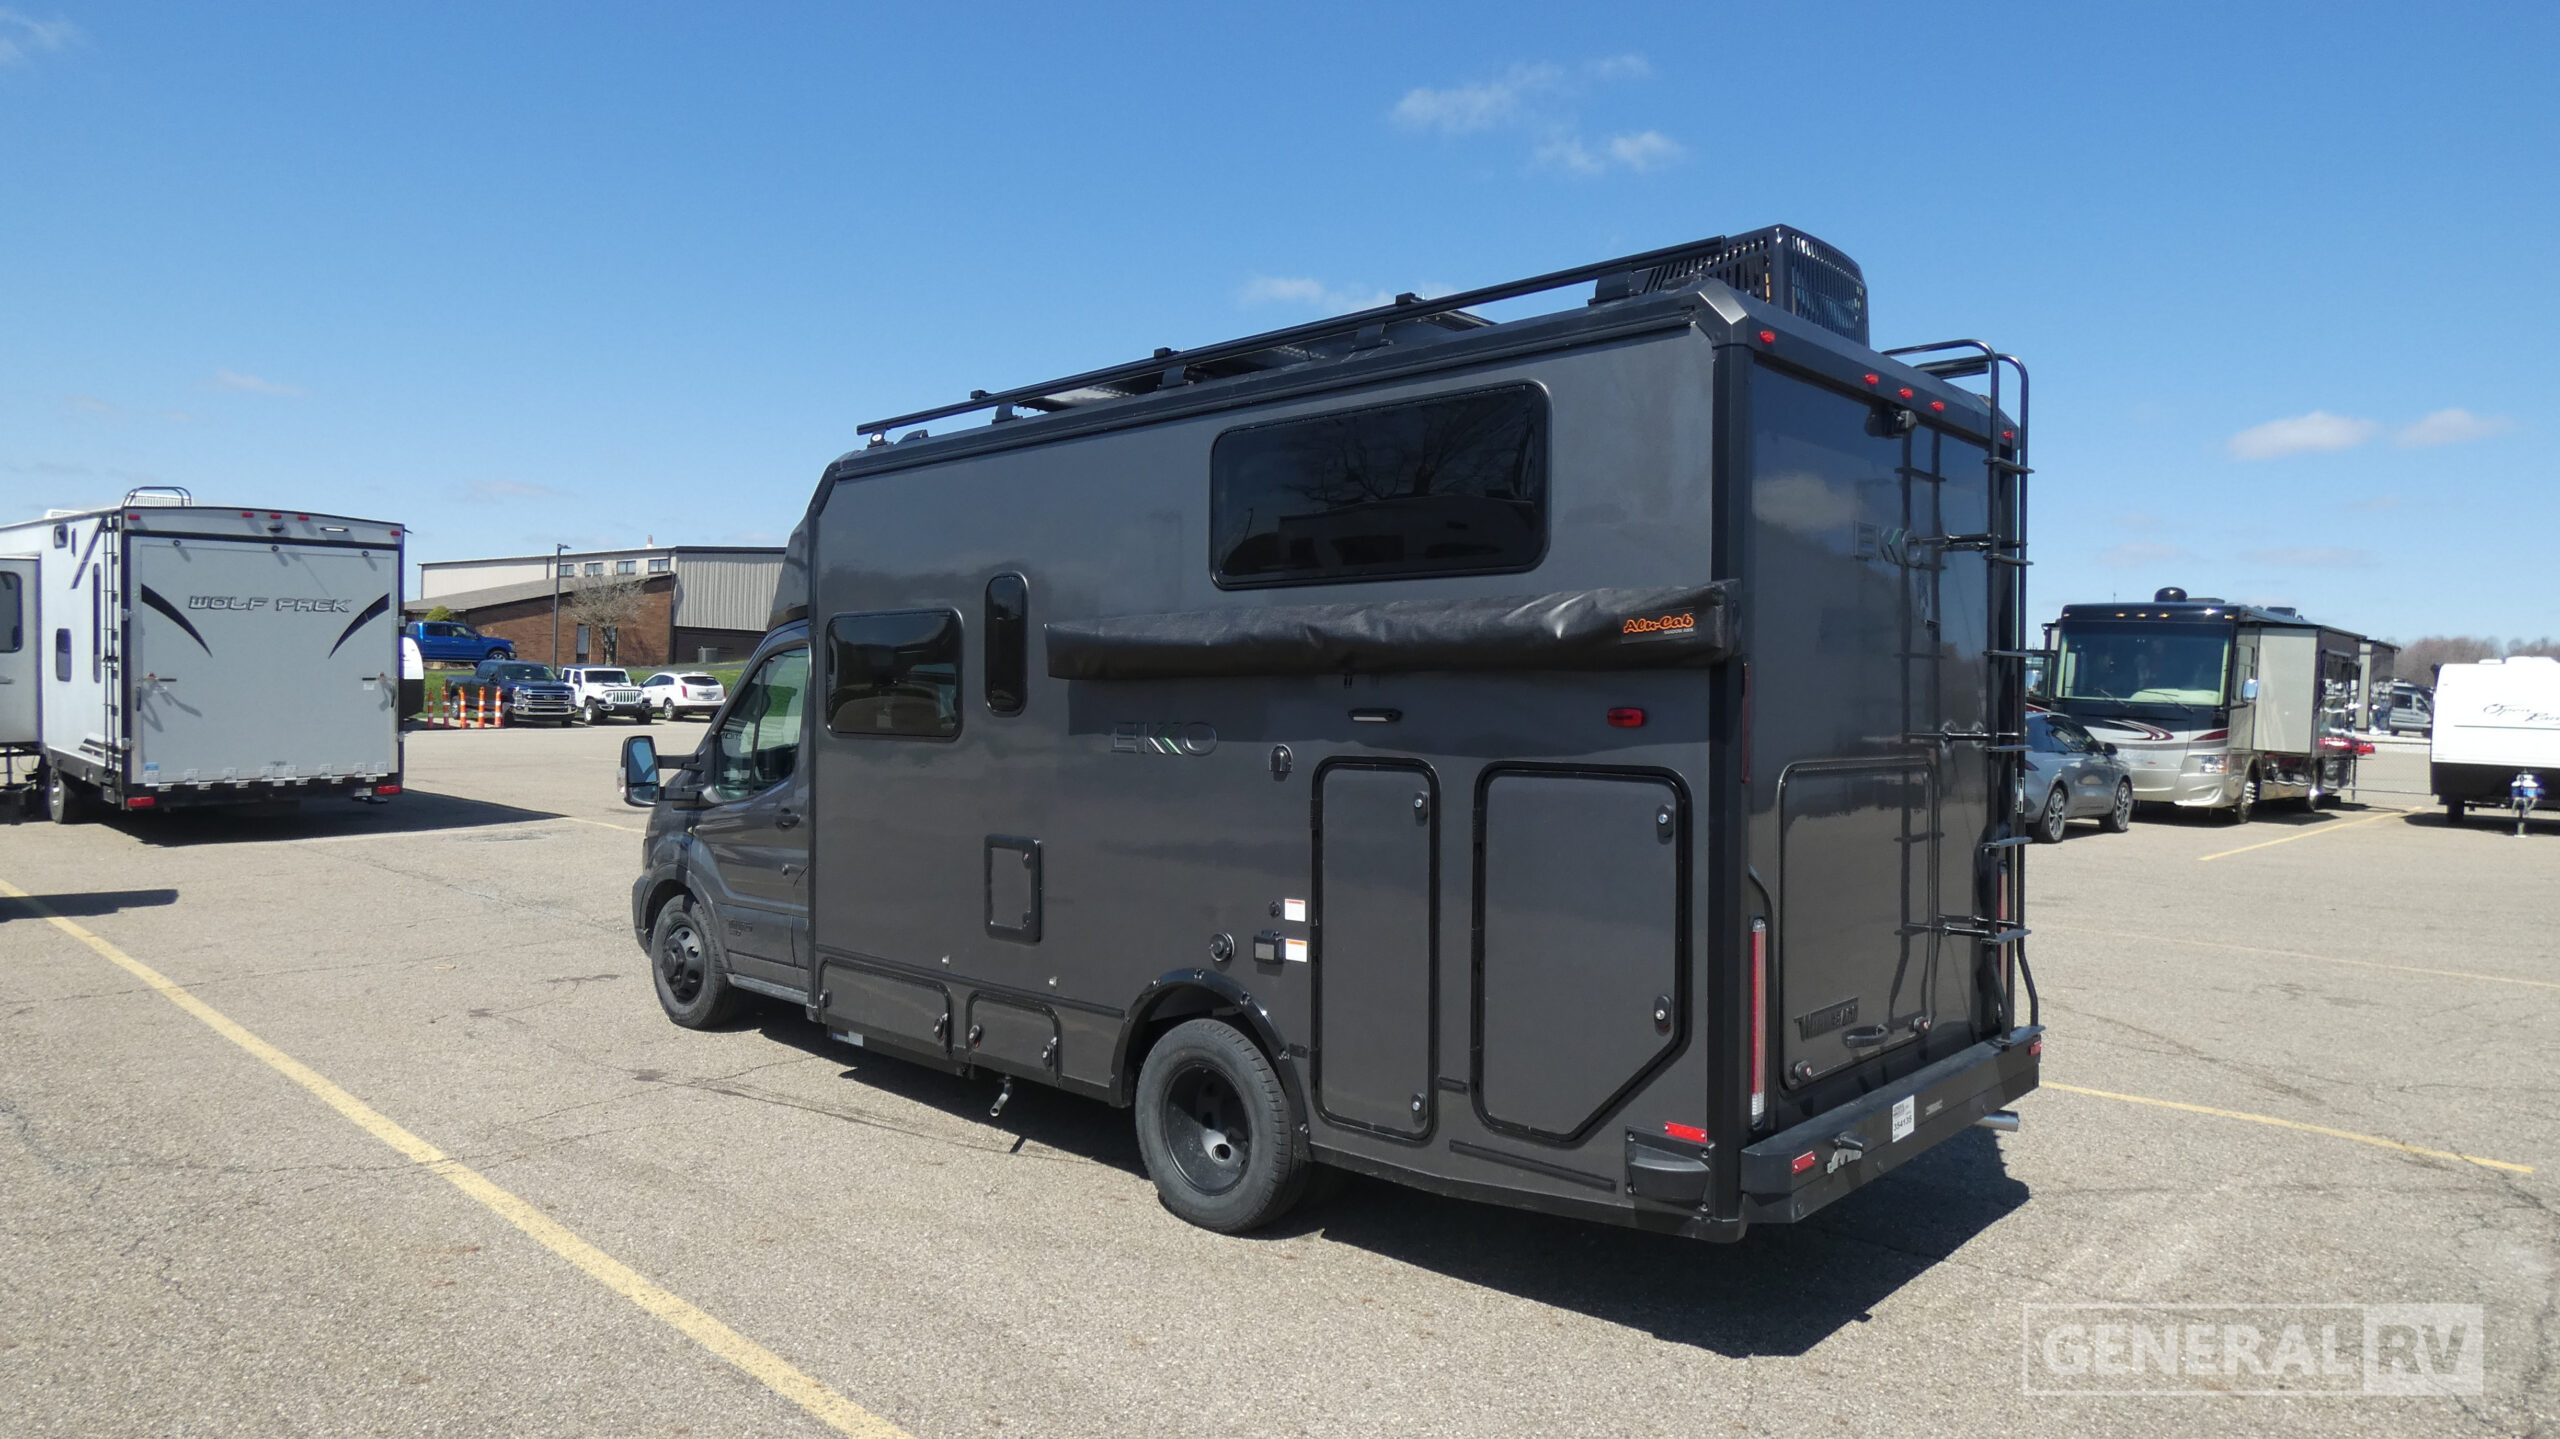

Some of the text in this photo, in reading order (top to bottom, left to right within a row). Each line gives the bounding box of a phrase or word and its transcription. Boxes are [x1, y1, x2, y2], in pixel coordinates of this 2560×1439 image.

[189, 595, 352, 613] WOLF PACK
[1623, 613, 1695, 634] Alu-Cab
